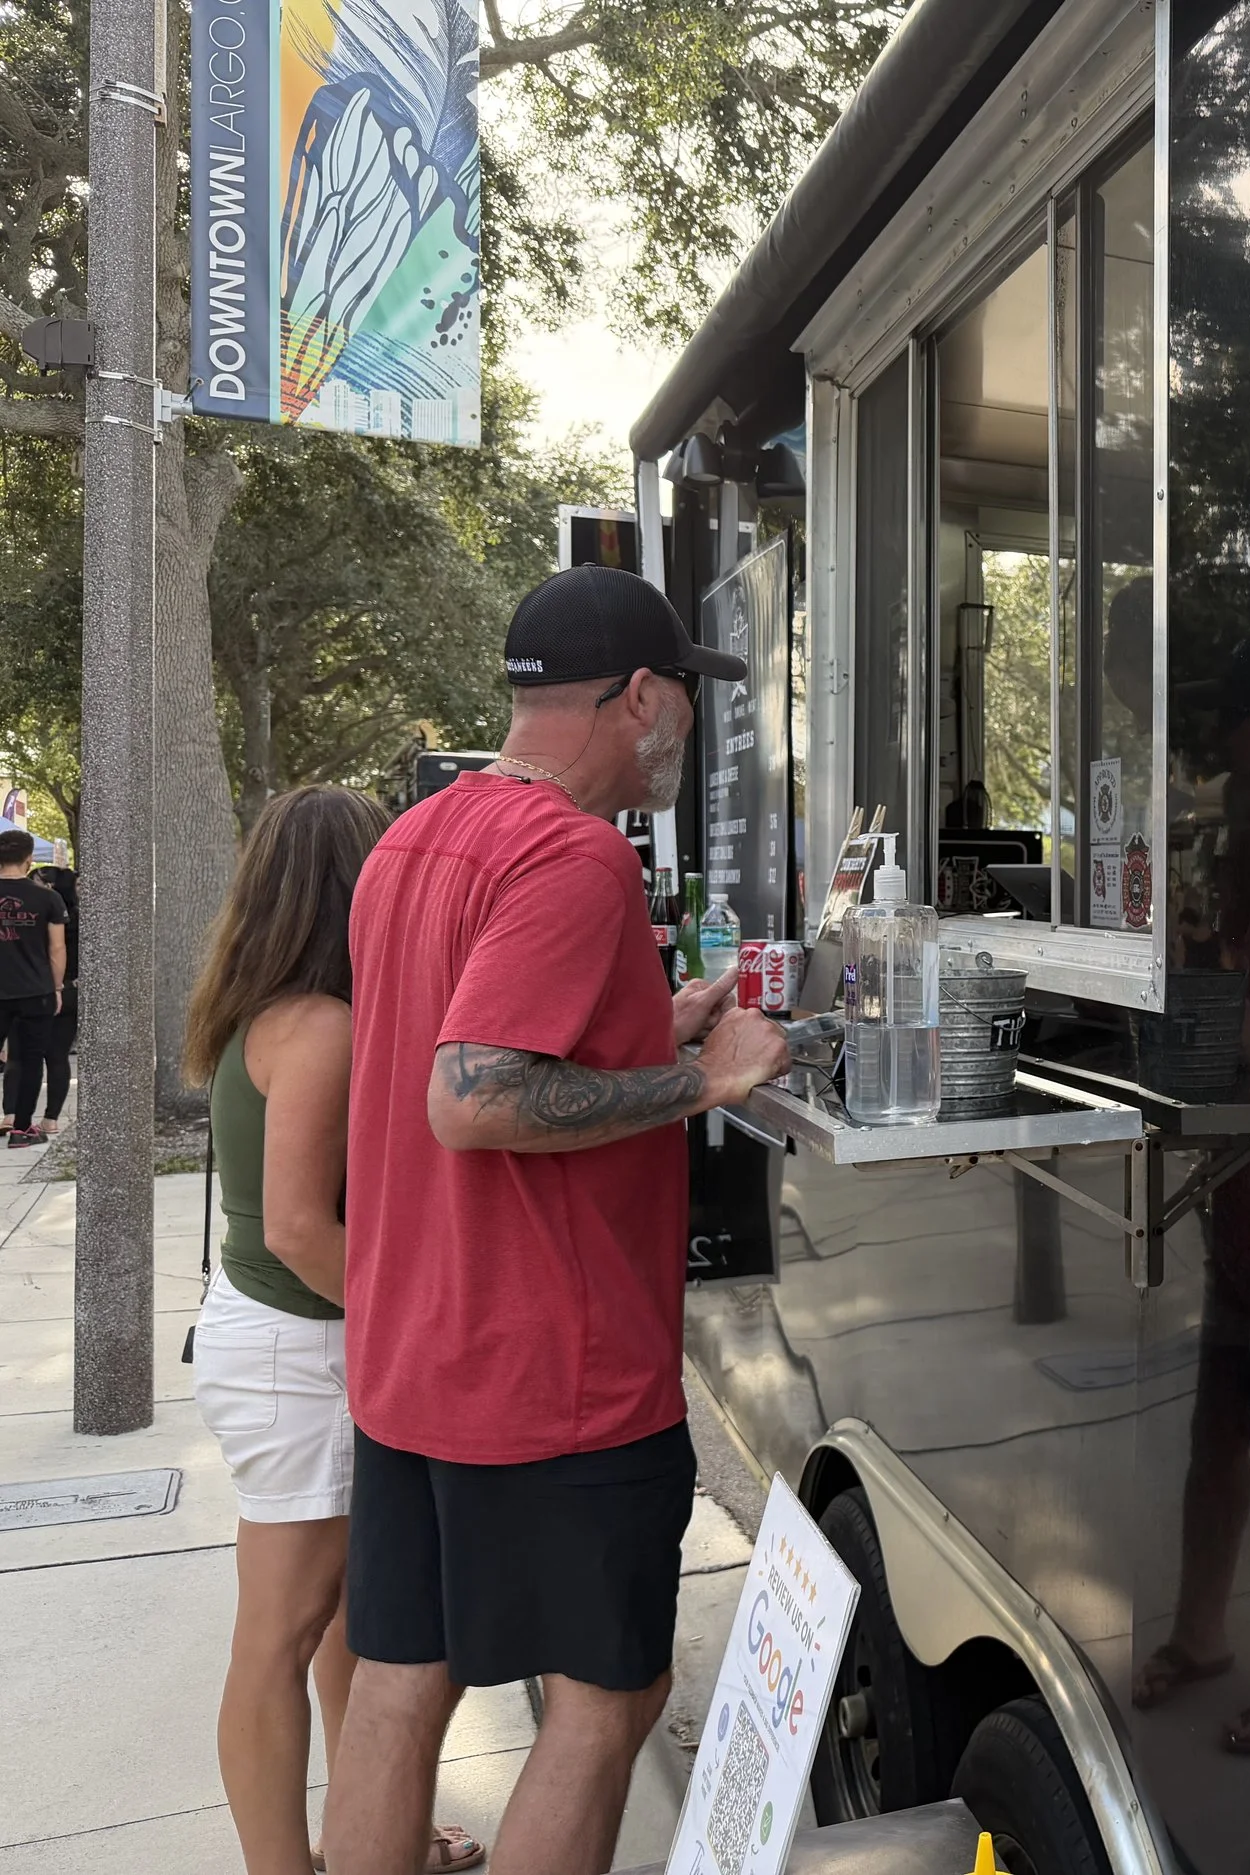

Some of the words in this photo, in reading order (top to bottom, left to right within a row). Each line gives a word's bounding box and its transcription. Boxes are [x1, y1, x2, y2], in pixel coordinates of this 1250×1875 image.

[765, 949, 785, 1011] Coke
[768, 1564, 795, 1616] REVIEW
[791, 1603, 803, 1633] US
[800, 1621, 814, 1653] ON
[748, 1589, 804, 1736] Google
